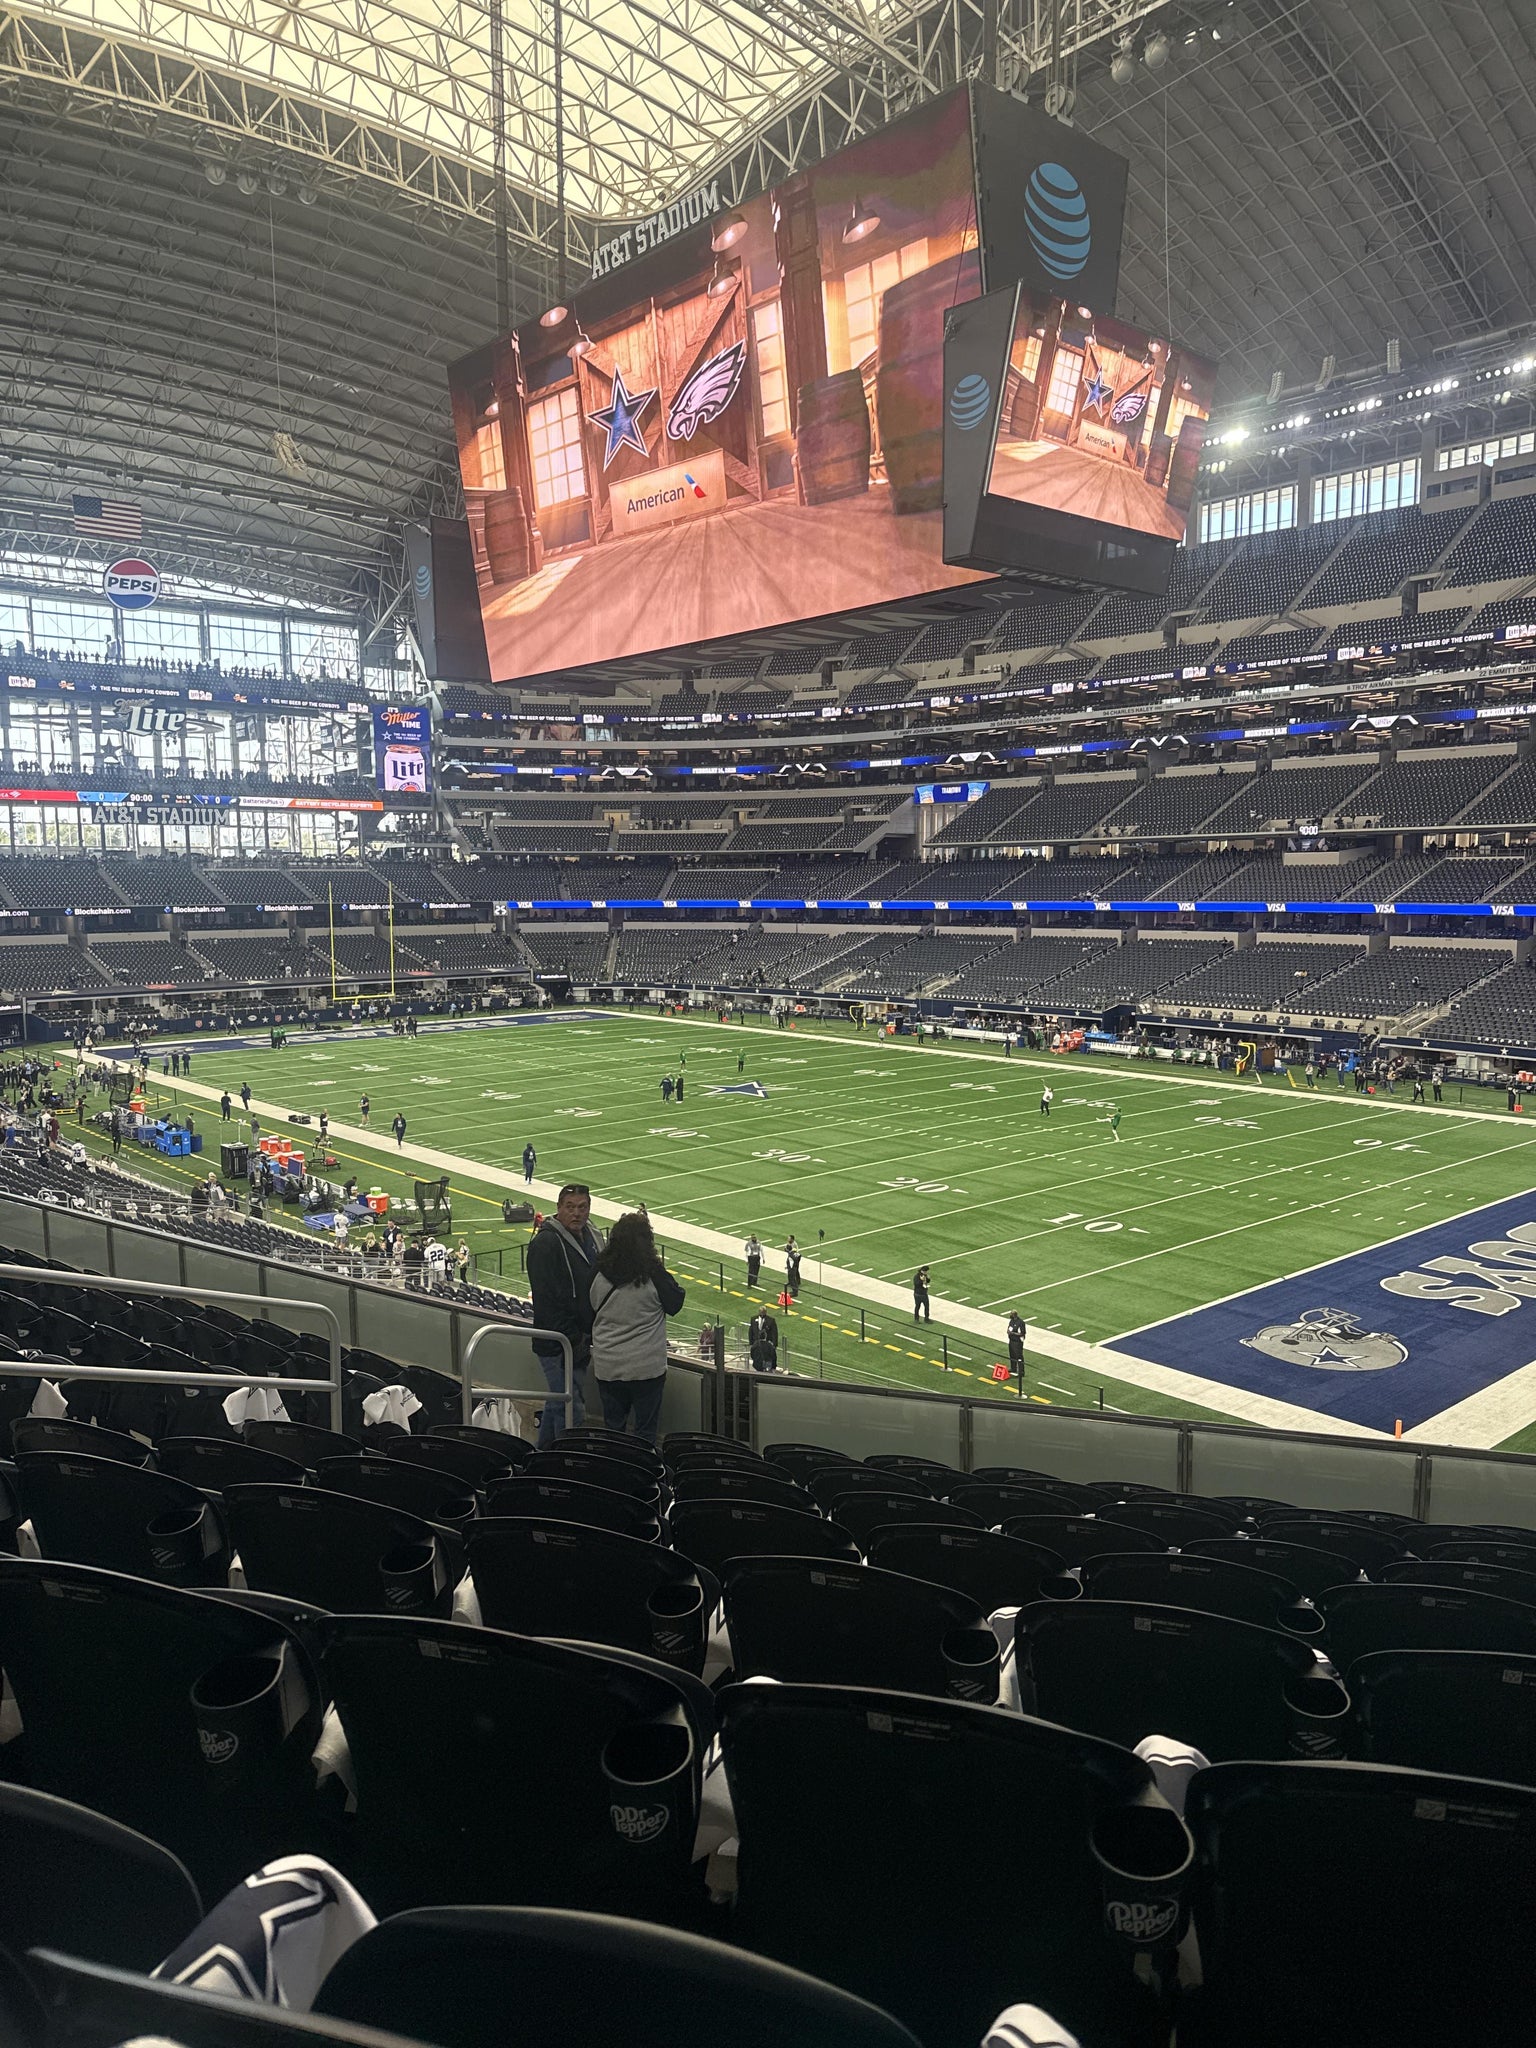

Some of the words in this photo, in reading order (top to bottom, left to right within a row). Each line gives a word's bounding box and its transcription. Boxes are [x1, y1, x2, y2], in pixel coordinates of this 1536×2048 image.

[591, 230, 632, 280] AT&T
[635, 180, 720, 255] STADIUM
[627, 486, 685, 515] American
[107, 576, 158, 594] PEPSI
[1424, 639, 1441, 648] BEER
[1441, 638, 1450, 646] OF
[1450, 636, 1463, 644] THE
[1463, 632, 1494, 642] COWBOYS
[1488, 667, 1516, 676] EMMITT
[1517, 665, 1536, 673] SMIT
[126, 706, 187, 736] Lite
[381, 711, 421, 726] Miller
[401, 721, 421, 729] TIME
[392, 760, 423, 780] Lite
[130, 793, 153, 802] 90:00
[93, 806, 142, 824] AT&T
[147, 807, 230, 826] STADIUM
[172, 906, 226, 914] Blockchain.com
[264, 904, 314, 912] Blockchain.com
[804, 901, 818, 909] VISA
[868, 901, 882, 909] VISA
[934, 902, 949, 910] VISA
[1011, 902, 1028, 910] VISA
[1094, 902, 1111, 911] VISA
[1177, 902, 1196, 912] VISA
[1266, 903, 1287, 913] VISA
[1373, 903, 1396, 914] VISA
[1490, 905, 1515, 916] VISA
[74, 907, 131, 916] Blockchain.com
[553, 1106, 602, 1118] 50
[646, 1127, 699, 1139] 40
[751, 1148, 811, 1163] 30
[877, 1175, 951, 1194] 20
[369, 1200, 377, 1209] G
[1041, 1212, 1125, 1235] 10
[430, 1249, 444, 1262] 22
[623, 1806, 648, 1823] Dr
[610, 1804, 665, 1838] Pepper
[1131, 1904, 1158, 1920] Dr
[1107, 1901, 1176, 1937] Pepper
